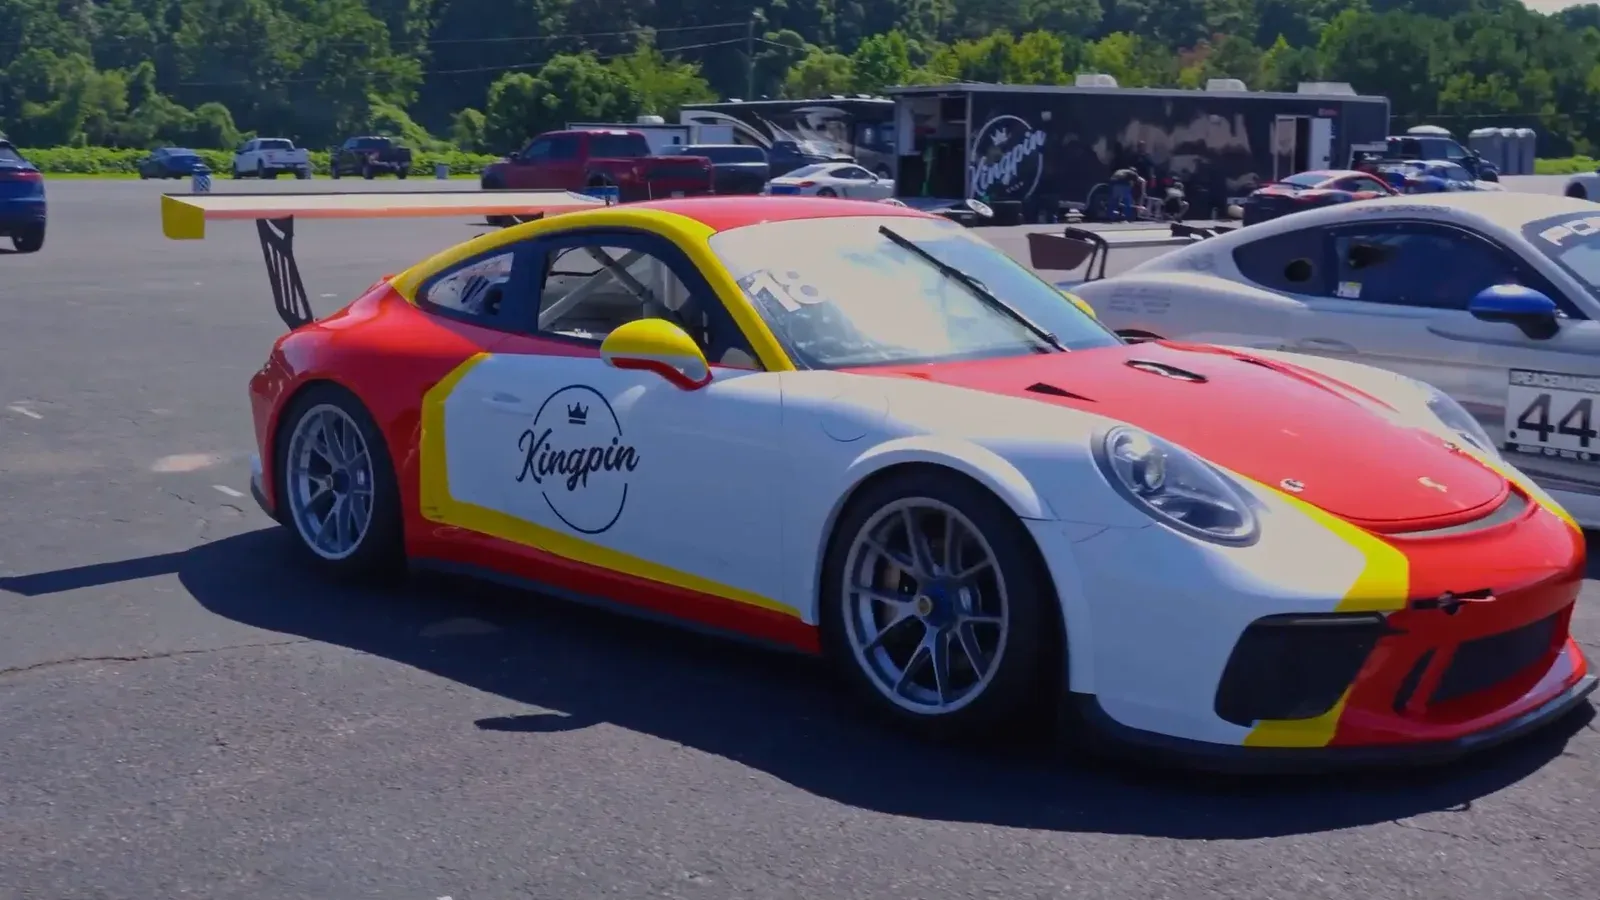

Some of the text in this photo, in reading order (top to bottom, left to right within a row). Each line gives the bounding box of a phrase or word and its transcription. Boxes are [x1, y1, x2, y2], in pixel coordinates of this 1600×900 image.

[968, 130, 1046, 200] Kingpin
[1517, 393, 1597, 448] 44
[516, 428, 640, 491] Kingpin
